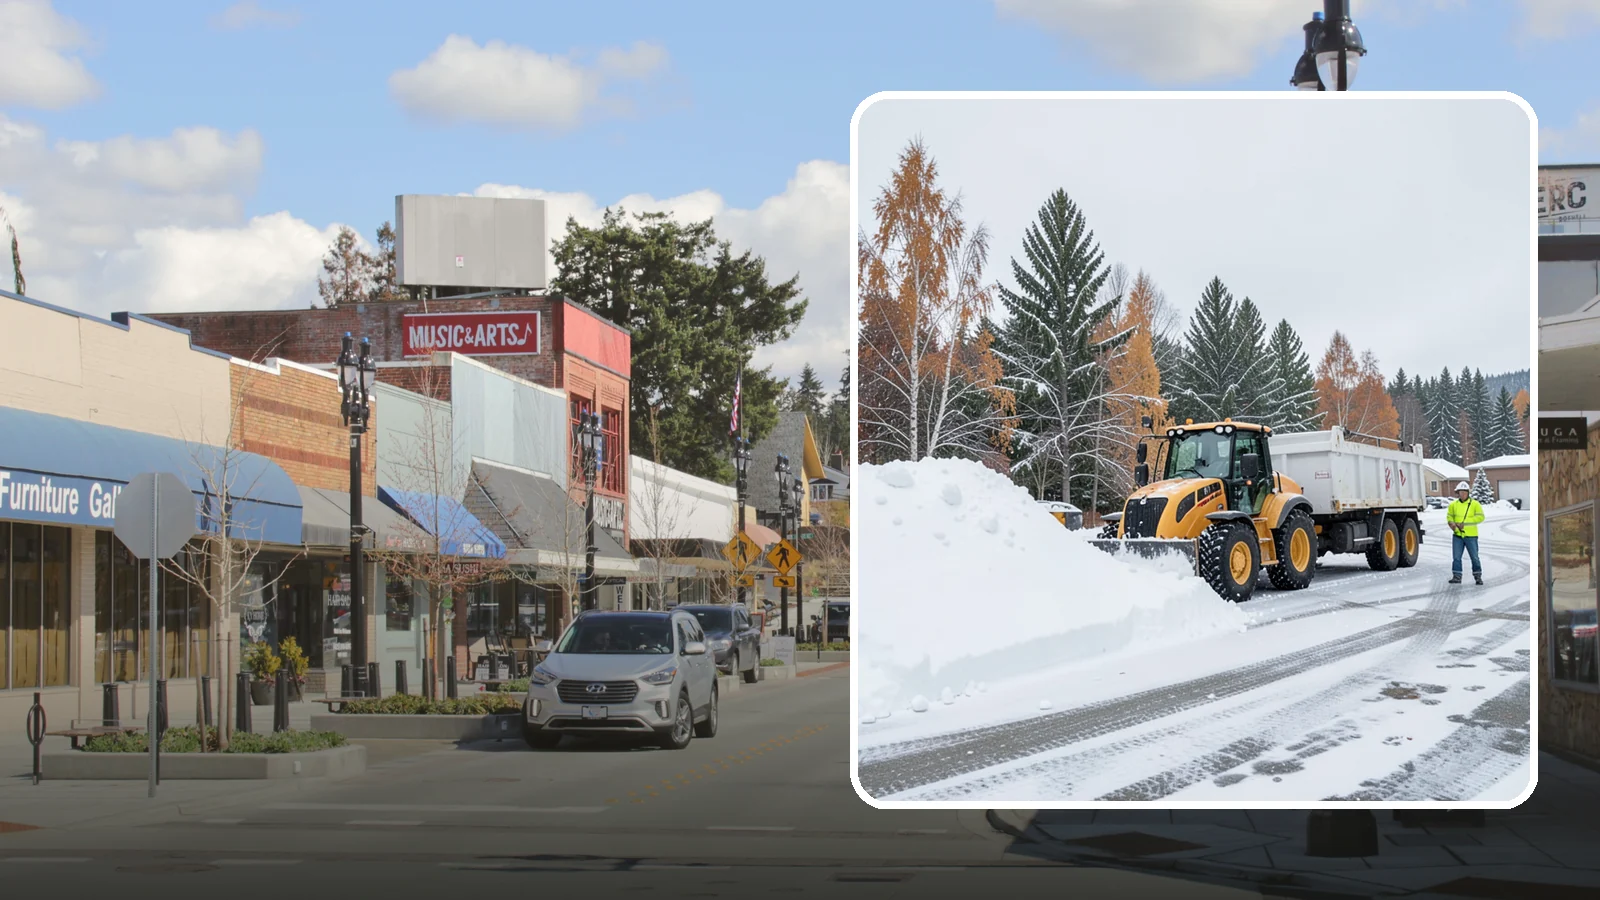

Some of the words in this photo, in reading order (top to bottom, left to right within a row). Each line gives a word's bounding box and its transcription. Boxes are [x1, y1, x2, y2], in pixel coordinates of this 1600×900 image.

[408, 323, 519, 349] MUSIC&ARTS
[0, 471, 79, 515] Furniture
[89, 482, 121, 519] Gal
